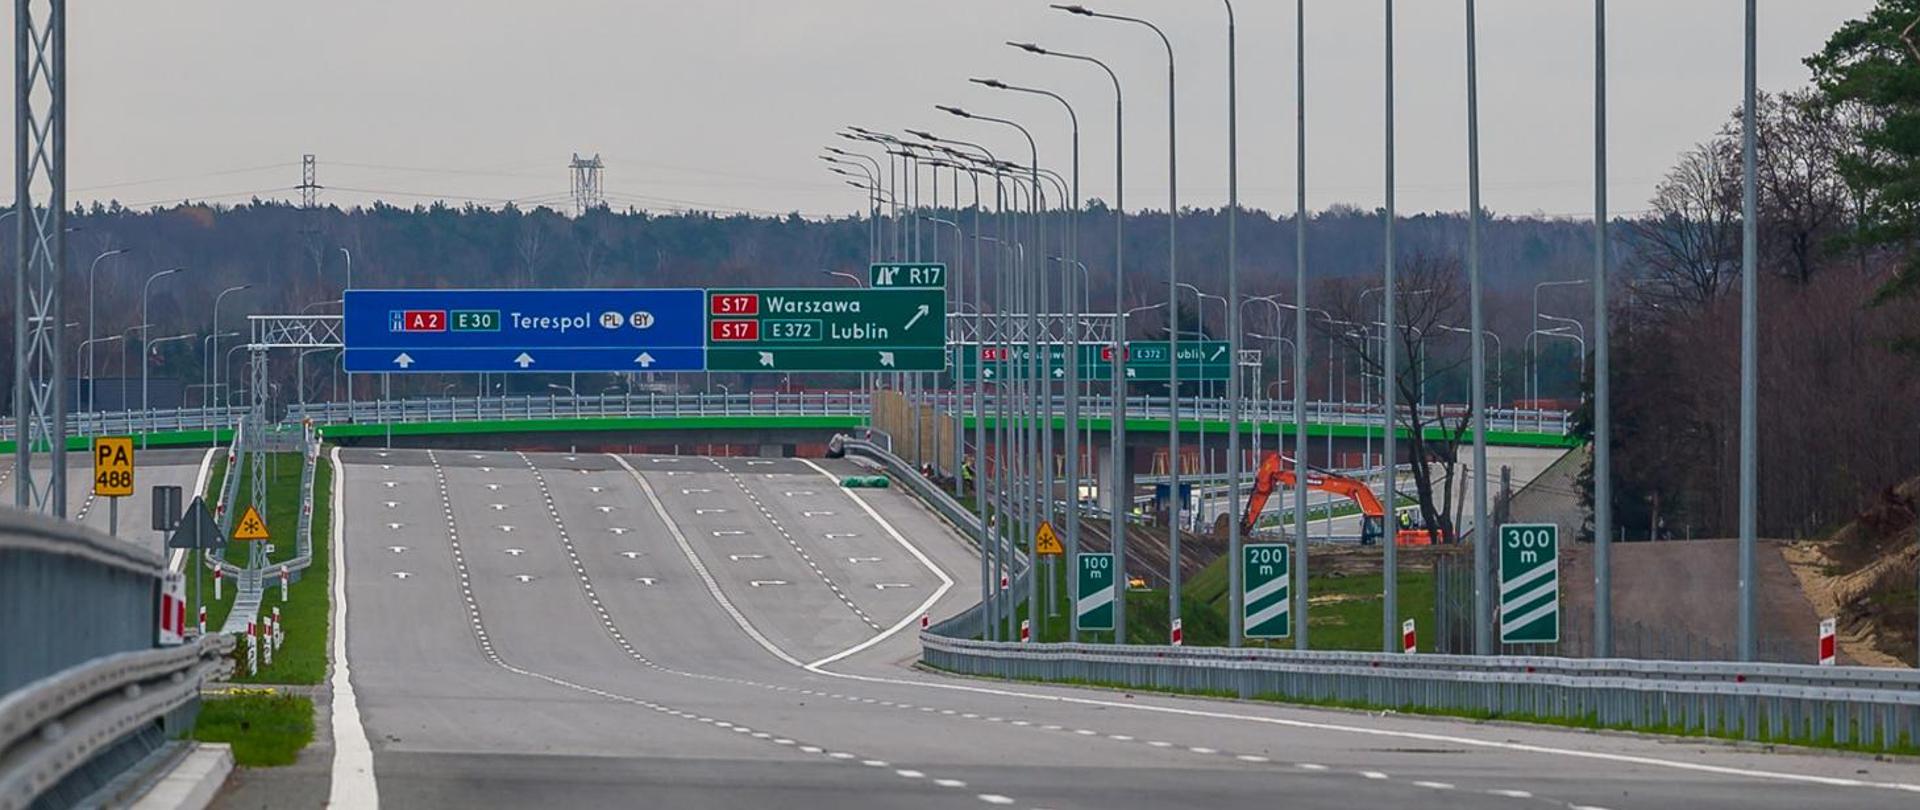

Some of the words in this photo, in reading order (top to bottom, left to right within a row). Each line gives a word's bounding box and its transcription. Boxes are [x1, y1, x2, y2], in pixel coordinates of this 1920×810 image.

[910, 268, 940, 284] R17
[766, 297, 861, 313] Warszawa
[511, 312, 590, 333] Terespol
[604, 315, 619, 326] PL
[634, 314, 649, 326] BY
[832, 323, 888, 339] Lublin
[1177, 348, 1206, 359] ublin
[99, 445, 129, 466] PA
[98, 471, 131, 488] 488
[1508, 530, 1550, 548] 300
[1084, 557, 1108, 569] 100
[1250, 549, 1282, 564] 200
[1521, 551, 1537, 563] m
[1090, 570, 1102, 579] m
[1260, 565, 1273, 576] m
